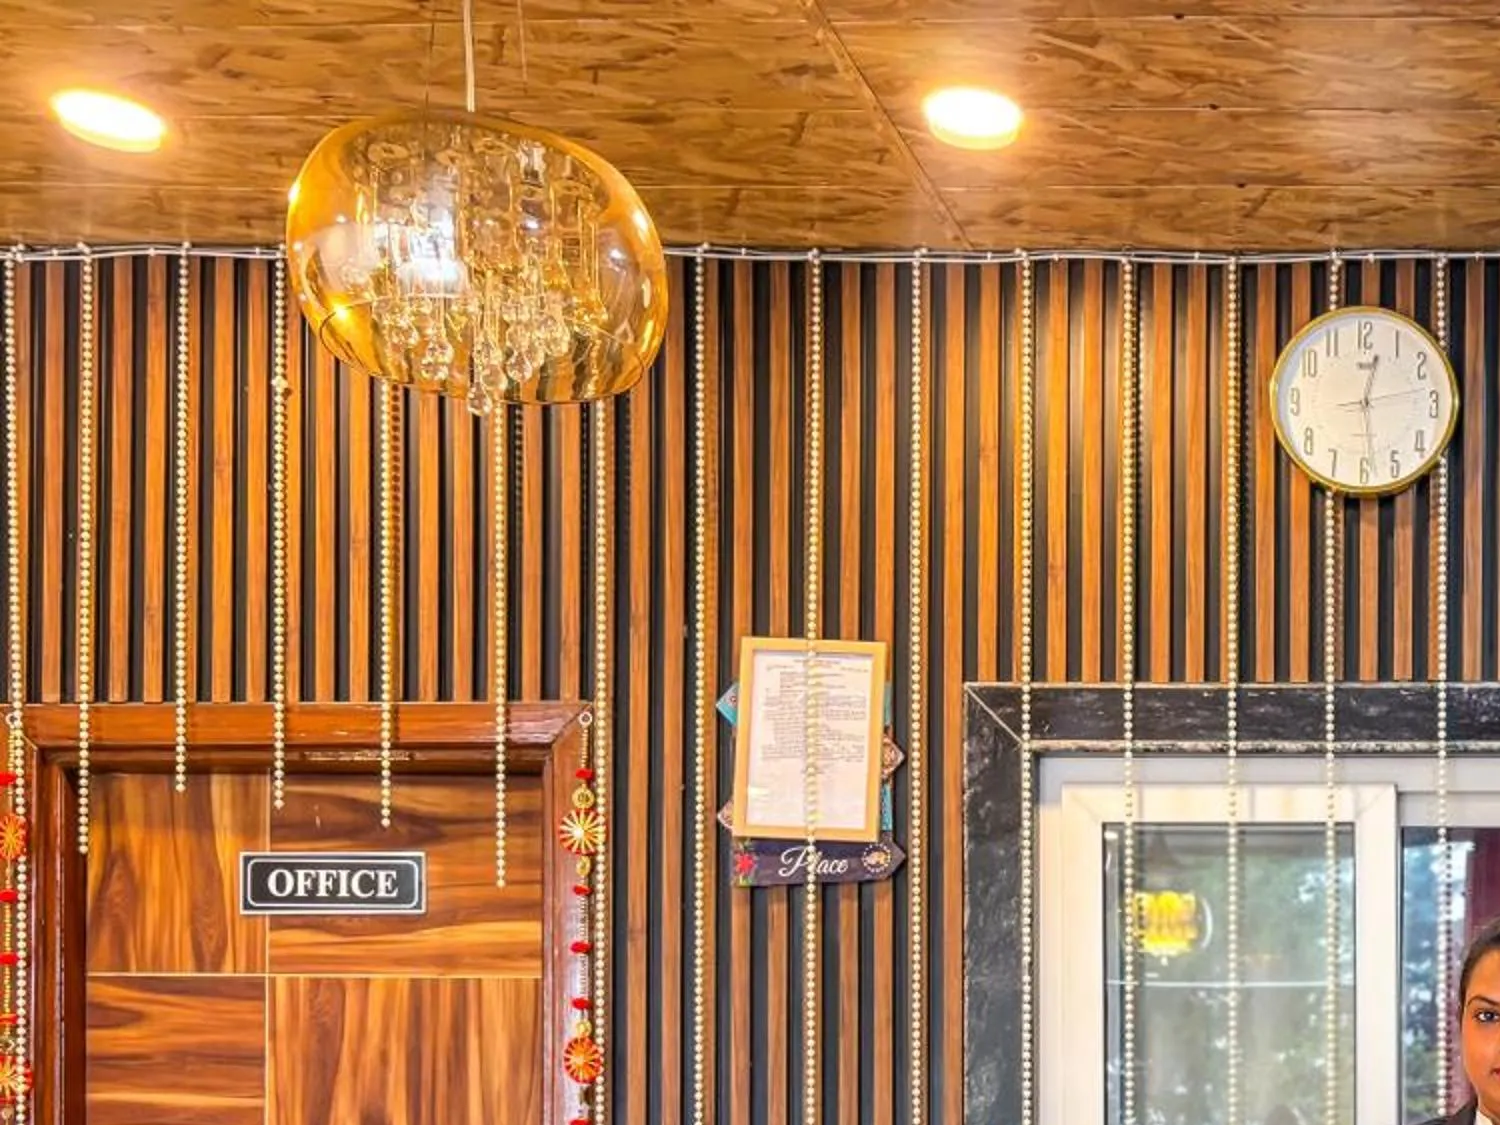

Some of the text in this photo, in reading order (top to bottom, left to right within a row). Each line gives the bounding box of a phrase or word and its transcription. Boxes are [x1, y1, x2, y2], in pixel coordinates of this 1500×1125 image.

[1326, 328, 1339, 358] 11
[1357, 320, 1374, 350] 12
[1394, 329, 1400, 359] 1
[1302, 349, 1318, 378] 10
[1416, 351, 1427, 381] 2
[1290, 387, 1301, 417] 9
[1428, 390, 1439, 419] 3
[1303, 427, 1315, 456] 8
[1415, 429, 1425, 458] 4
[1328, 448, 1338, 478] 7
[1359, 457, 1370, 485] 6
[1390, 450, 1401, 479] 5
[267, 869, 399, 898] OFFICE
